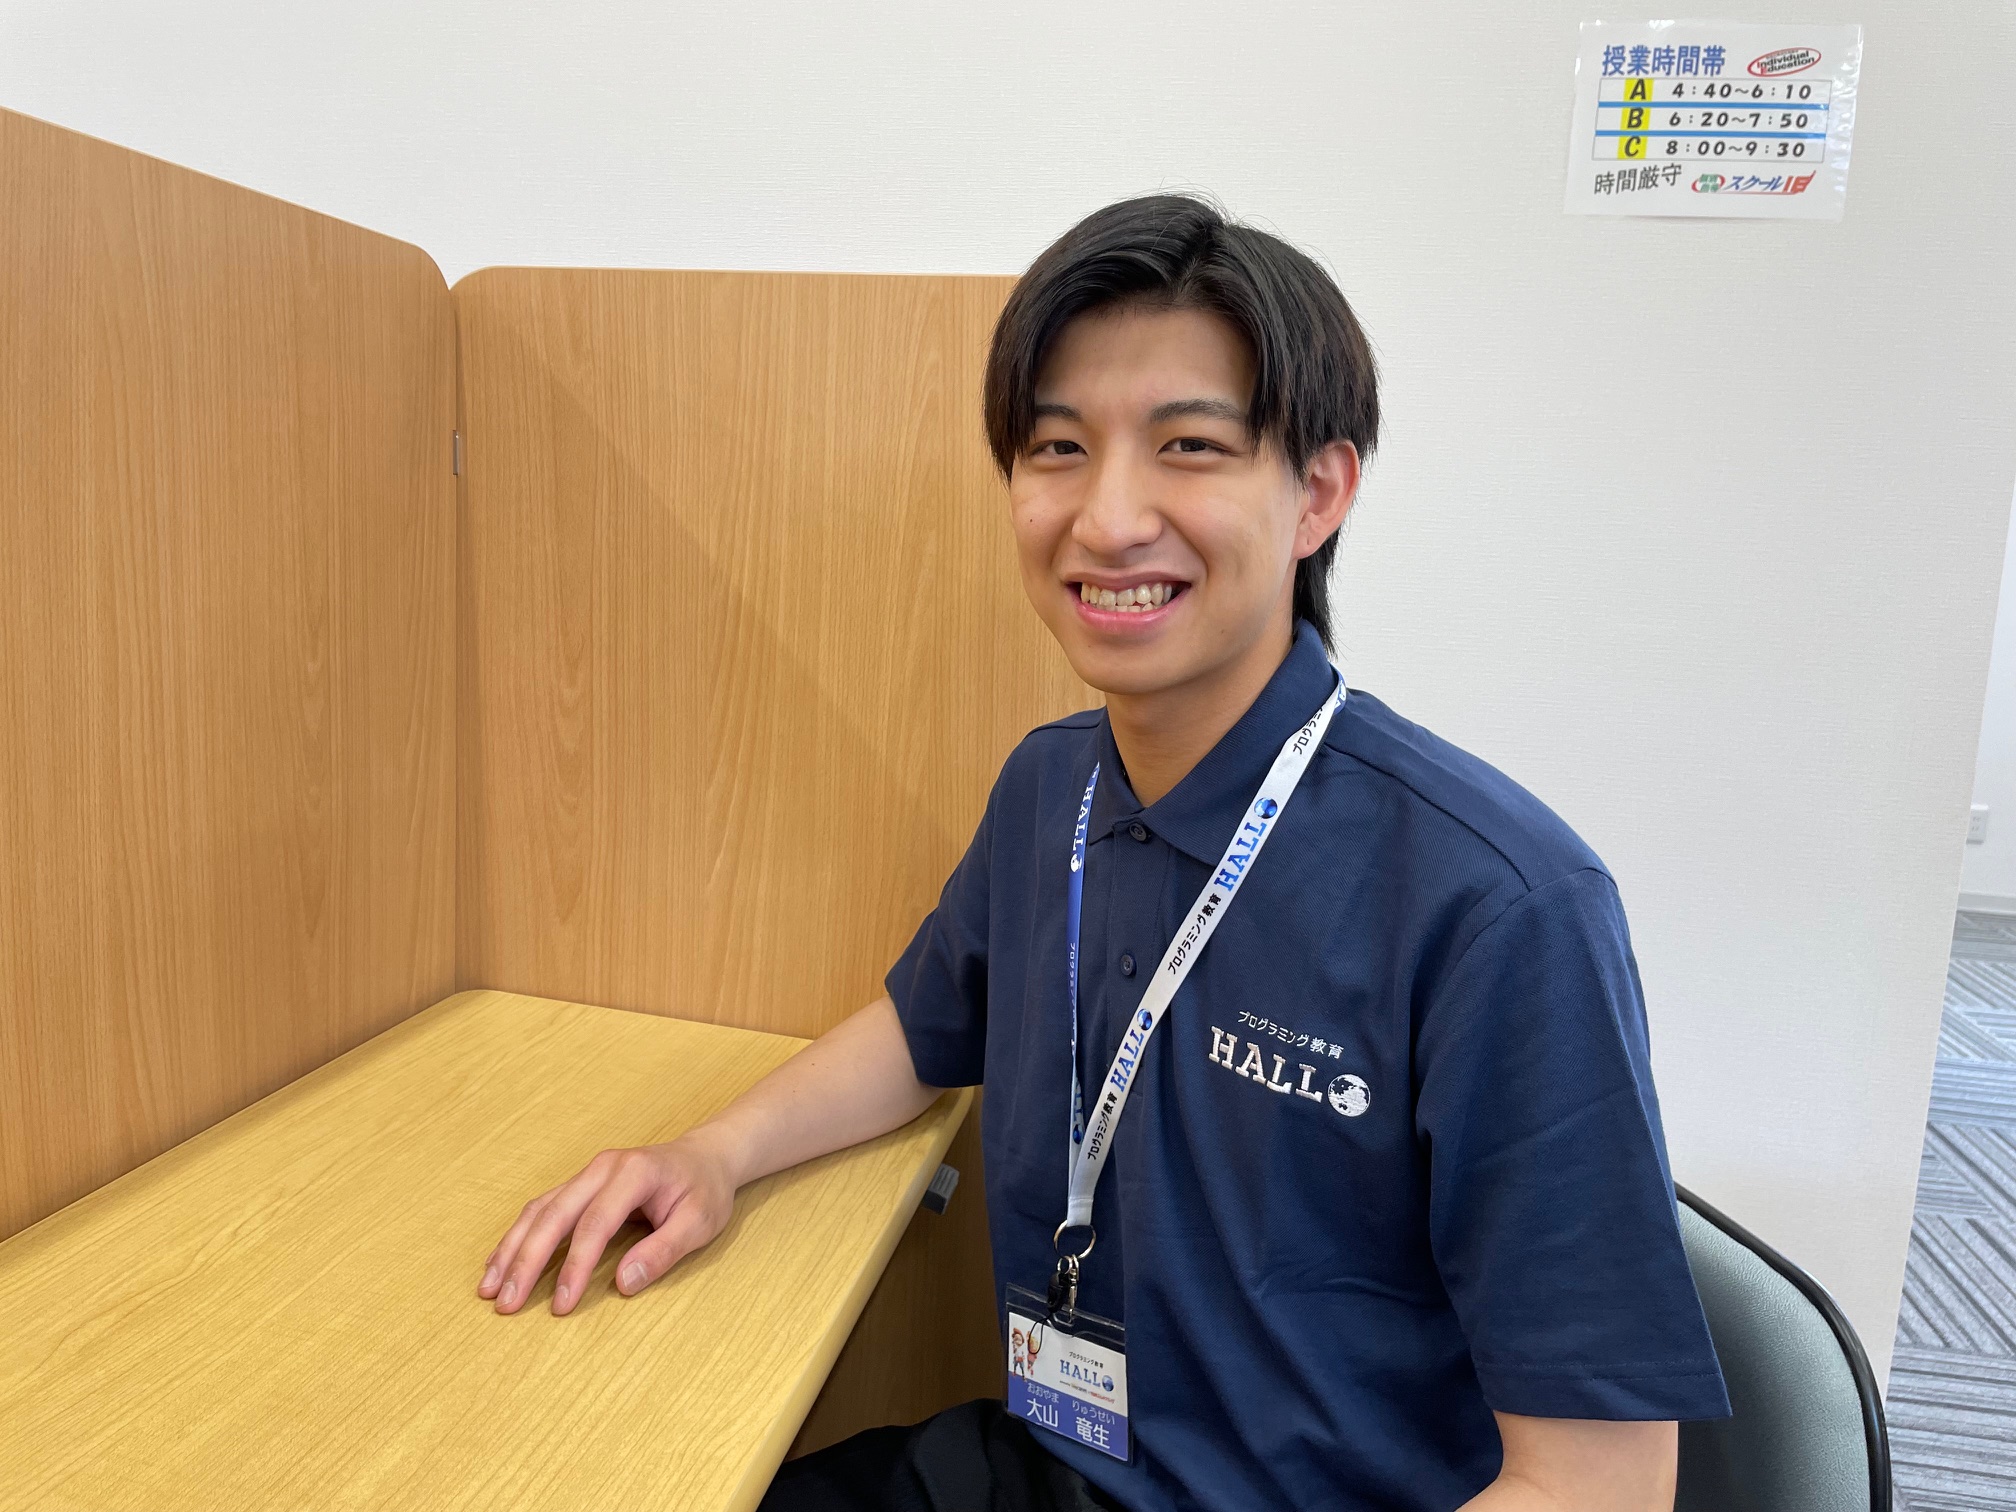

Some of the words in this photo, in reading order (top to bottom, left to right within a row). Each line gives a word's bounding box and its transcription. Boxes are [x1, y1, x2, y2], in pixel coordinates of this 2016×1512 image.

[1601, 45, 1726, 77] 授業時間帯
[1757, 50, 1809, 68] Individual
[1760, 57, 1815, 75] Education
[1629, 79, 1647, 100] A
[1626, 108, 1644, 129] B
[1623, 136, 1641, 157] C
[1593, 163, 1682, 196] 時間厳守
[1167, 892, 1222, 975] プログラミング教育
[1237, 1010, 1345, 1060] プログラミング教育
[1087, 1091, 1118, 1161] プログラミング教育
[1027, 1382, 1060, 1404] おおやま
[1072, 1400, 1115, 1425] りゅうせい
[1026, 1398, 1059, 1428] 大山
[1075, 1416, 1110, 1449] 竜生
